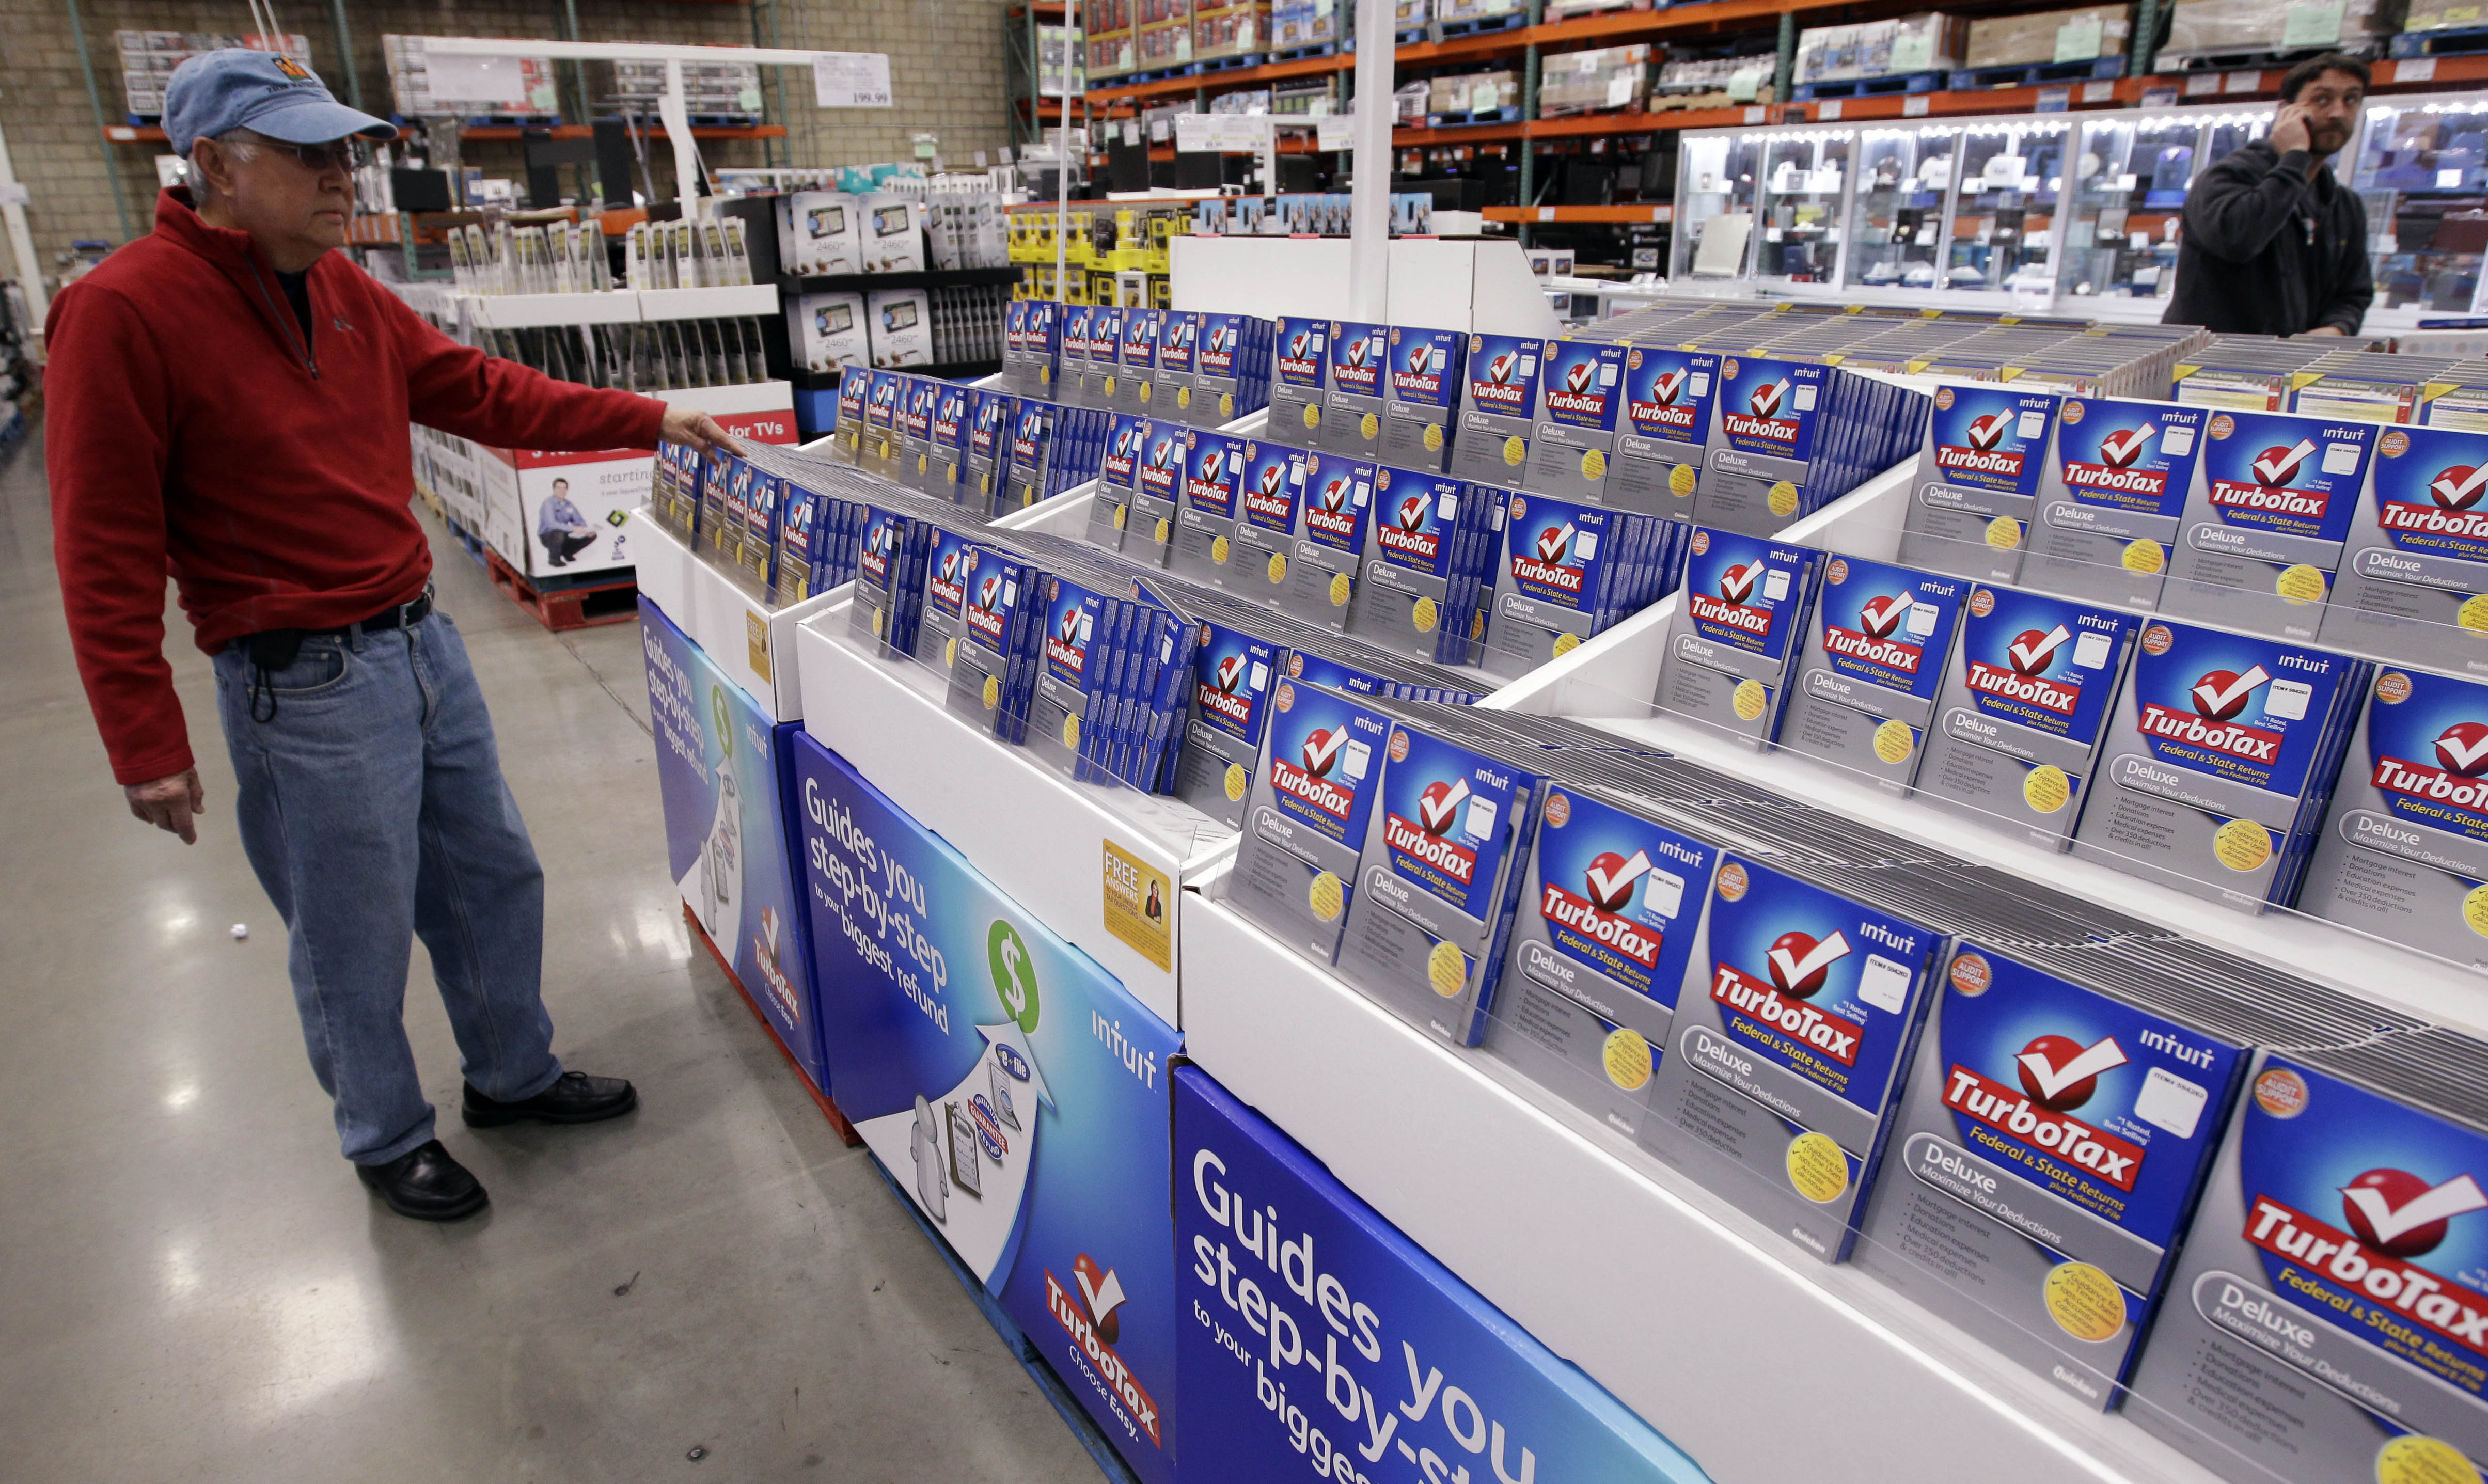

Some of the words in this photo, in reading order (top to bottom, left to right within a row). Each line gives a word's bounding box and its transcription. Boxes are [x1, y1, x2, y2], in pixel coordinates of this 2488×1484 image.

[854, 92, 887, 103] 199.99
[816, 240, 839, 251] 2460
[882, 239, 903, 248] 2460
[826, 338, 847, 348] 2460
[891, 335, 912, 344] 2460
[1280, 358, 1315, 373] TurboTax
[2222, 373, 2242, 381] Business
[1395, 373, 1438, 390] TurboTax
[1391, 403, 1409, 413] Deluxe
[1548, 392, 1603, 412] TurboTax
[729, 425, 751, 438] for
[753, 421, 784, 436] TVs
[1726, 415, 1796, 439] TurboTax
[2323, 427, 2365, 440] intuit
[1719, 452, 1747, 466] Deluxe
[1939, 447, 2020, 472] TurboTax
[1189, 479, 1228, 501] TurboTax
[2066, 464, 2163, 492] TurboTax
[2213, 483, 2324, 514] TurboTax
[748, 509, 768, 528] TurboTax
[1307, 508, 1353, 533] TurboTax
[1579, 513, 1603, 525] intuit
[785, 526, 807, 548] TurboTax
[2200, 527, 2245, 544] Deluxe
[1514, 558, 1580, 589] TurboTax
[1920, 581, 1955, 596] intuit
[968, 605, 1002, 635] TurboTax
[1692, 596, 1768, 632] TurboTax
[2077, 614, 2118, 631] intuit
[1826, 628, 1917, 669] TurboTax
[2143, 637, 2168, 648] SUPPORT
[2148, 633, 2167, 641] AUDIT
[644, 625, 674, 683] Guides
[674, 663, 693, 703] you
[2278, 655, 2329, 673] intuit
[1814, 673, 1850, 694] Deluxe
[1970, 665, 2074, 711] TurboTax
[649, 669, 704, 756] step-by-step
[1199, 684, 1248, 720] TurboTax
[746, 722, 768, 760] intuit
[2143, 707, 2276, 760] TurboTax
[664, 719, 687, 760] biggest
[686, 748, 708, 785] refund
[2158, 742, 2199, 760] Federal
[2206, 754, 2236, 770] State
[2237, 764, 2270, 779] Returns
[1475, 769, 1508, 791] intuit
[2126, 760, 2178, 786] Deluxe
[2229, 771, 2251, 781] Federal
[2250, 777, 2267, 785] E-File
[1273, 762, 1349, 815] TurboTax
[2122, 775, 2160, 792] Maximize
[2162, 785, 2179, 796] Your
[2179, 791, 2226, 810] Deductions
[2118, 804, 2149, 818] Donations
[2120, 797, 2151, 810] Mortgage
[2151, 807, 2174, 817] interest
[2113, 819, 2137, 830] Medical
[2137, 828, 2165, 840] expenses
[2115, 812, 2146, 825] Education
[2146, 822, 2175, 834] expenses
[2358, 816, 2420, 845] Deluxe
[805, 777, 878, 874] Guides
[880, 848, 927, 920] you
[1387, 817, 1471, 879] TurboTax
[2111, 827, 2125, 835] Over
[2125, 831, 2137, 839] 350
[2137, 835, 2171, 850] deductions
[2114, 835, 2134, 845] credits
[2232, 828, 2259, 843] Guidance
[2258, 839, 2268, 847] for
[2235, 834, 2250, 845] Time
[2250, 842, 2266, 853] Users
[2221, 848, 2252, 865] Calculations
[2227, 845, 2249, 858] Accurate
[2237, 843, 2264, 859] Guaranteed
[1105, 851, 1139, 892] FREE
[1105, 875, 1139, 904] ANSWERS
[1111, 889, 1122, 901] YOUR
[1122, 895, 1139, 912] UNIQUE
[811, 836, 947, 994] step-by-step
[1106, 894, 1114, 904] TAX
[1114, 899, 1139, 920] QUESTIONS
[1545, 888, 1656, 962] TurboTax
[1860, 923, 1915, 954] intuit
[814, 882, 824, 901] to
[824, 893, 840, 915] your
[841, 905, 894, 982] biggest
[897, 965, 949, 1036] refund
[1958, 962, 1983, 977] AUDIT
[754, 937, 799, 1018] TurboTax
[1951, 968, 1985, 987] SUPPORT
[1716, 968, 1855, 1059] TurboTax
[1091, 1008, 1157, 1091] intuit
[1697, 1034, 1751, 1076] Deluxe
[2140, 1030, 2214, 1068] intuit
[974, 1096, 998, 1125] MAXIMUM
[970, 1104, 1006, 1149] GUARANTEE
[1949, 1070, 2134, 1181] TurboTax
[979, 1128, 999, 1156] REFUND
[1925, 1143, 1996, 1193] Deluxe
[1970, 1126, 2026, 1160] Federal
[2024, 1155, 2035, 1166] &
[2035, 1158, 2077, 1187] State
[2078, 1181, 2125, 1211] Returns
[2253, 1203, 2488, 1345] TurboTax
[1193, 1148, 1381, 1363] Guides
[1400, 1340, 1536, 1484] you
[2221, 1284, 2313, 1348] Deluxe
[1193, 1299, 1211, 1328] to
[1215, 1321, 1251, 1367] your
[1047, 1273, 1156, 1438] TurboTax
[1069, 1345, 1107, 1401] Choose
[1110, 1395, 1139, 1443] Easy.
[1256, 1358, 1372, 1484] bigge
